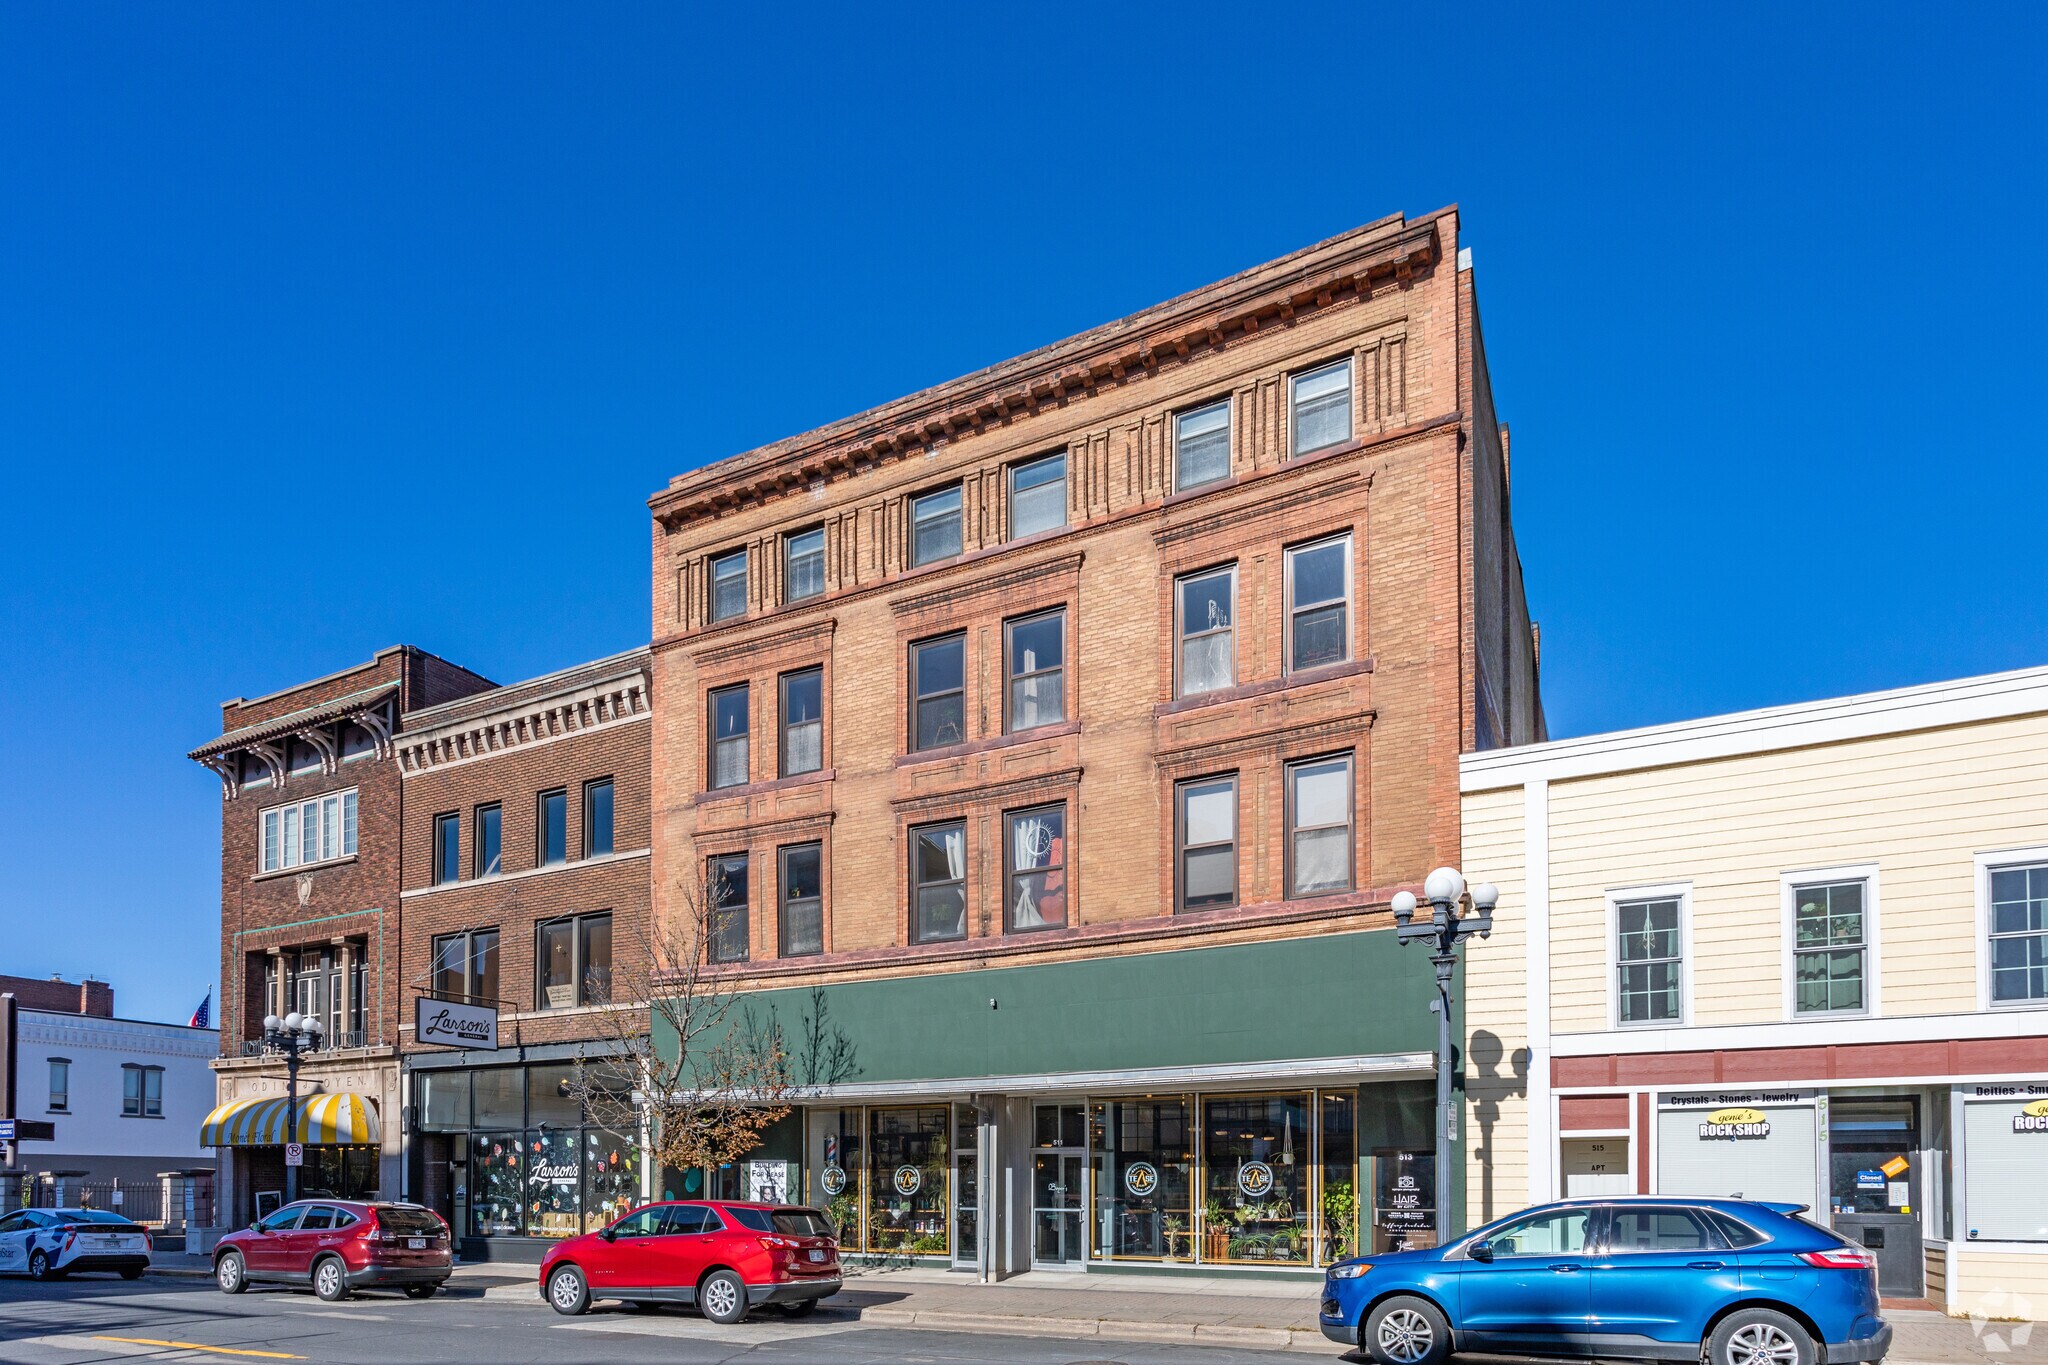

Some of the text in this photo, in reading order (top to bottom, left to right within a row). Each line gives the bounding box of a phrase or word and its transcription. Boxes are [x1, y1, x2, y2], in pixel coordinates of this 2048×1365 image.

[426, 1009, 490, 1035] Larson's
[252, 1082, 289, 1091] ODIN
[303, 1081, 310, 1089] J.
[1976, 1086, 2015, 1096] Deities
[1671, 1092, 1799, 1106] Crystals Stones Jewelry
[1700, 1123, 1770, 1136] ROCK SHOP
[252, 1130, 276, 1143] Floral
[1399, 1153, 1413, 1161] 513
[529, 1158, 579, 1185] Larson's
[754, 1161, 782, 1169] BUILDING
[751, 1170, 764, 1178] FOR
[1129, 1169, 1155, 1187] TEASE
[1242, 1169, 1270, 1187] TEASE
[1393, 1194, 1420, 1205] HAIR
